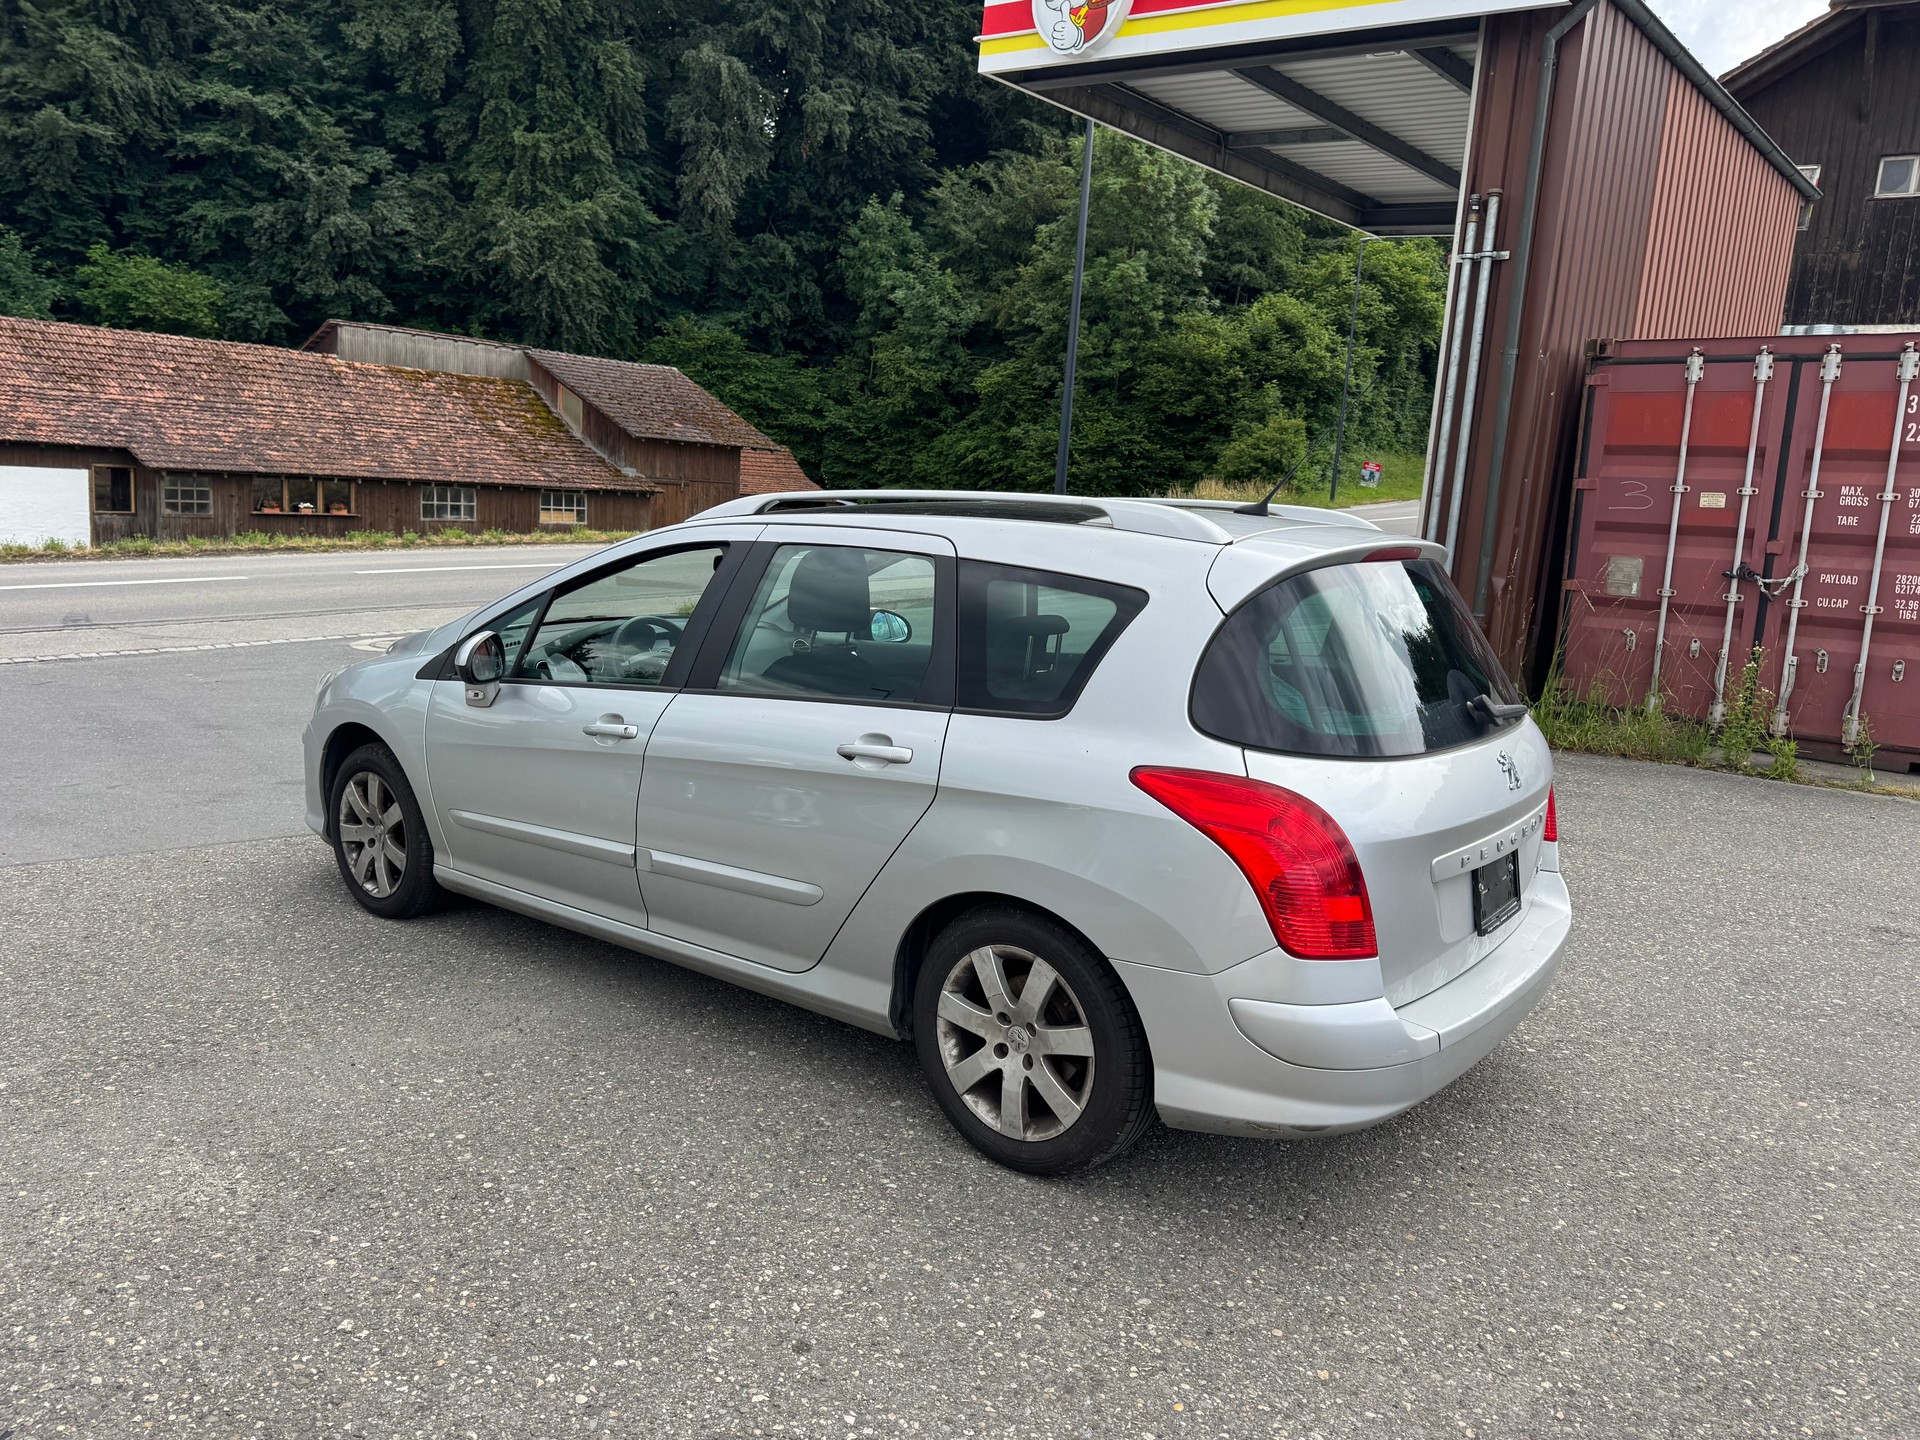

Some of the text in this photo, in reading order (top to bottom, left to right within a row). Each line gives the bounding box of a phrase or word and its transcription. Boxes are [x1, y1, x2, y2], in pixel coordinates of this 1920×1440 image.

[1907, 394, 1919, 414] 3
[1608, 481, 1654, 510] 3
[1840, 485, 1865, 497] MAX.
[1839, 496, 1869, 507] GROSS
[1908, 498, 1920, 509] 67
[1837, 515, 1859, 526] TARE
[1820, 573, 1859, 585] PAYLOAD
[1895, 584, 1920, 595] 62174
[1817, 597, 1849, 609] CU.CAP
[1894, 599, 1919, 610] 32.96
[1898, 610, 1918, 621] 1164
[1461, 812, 1544, 869] PEUGEOT
